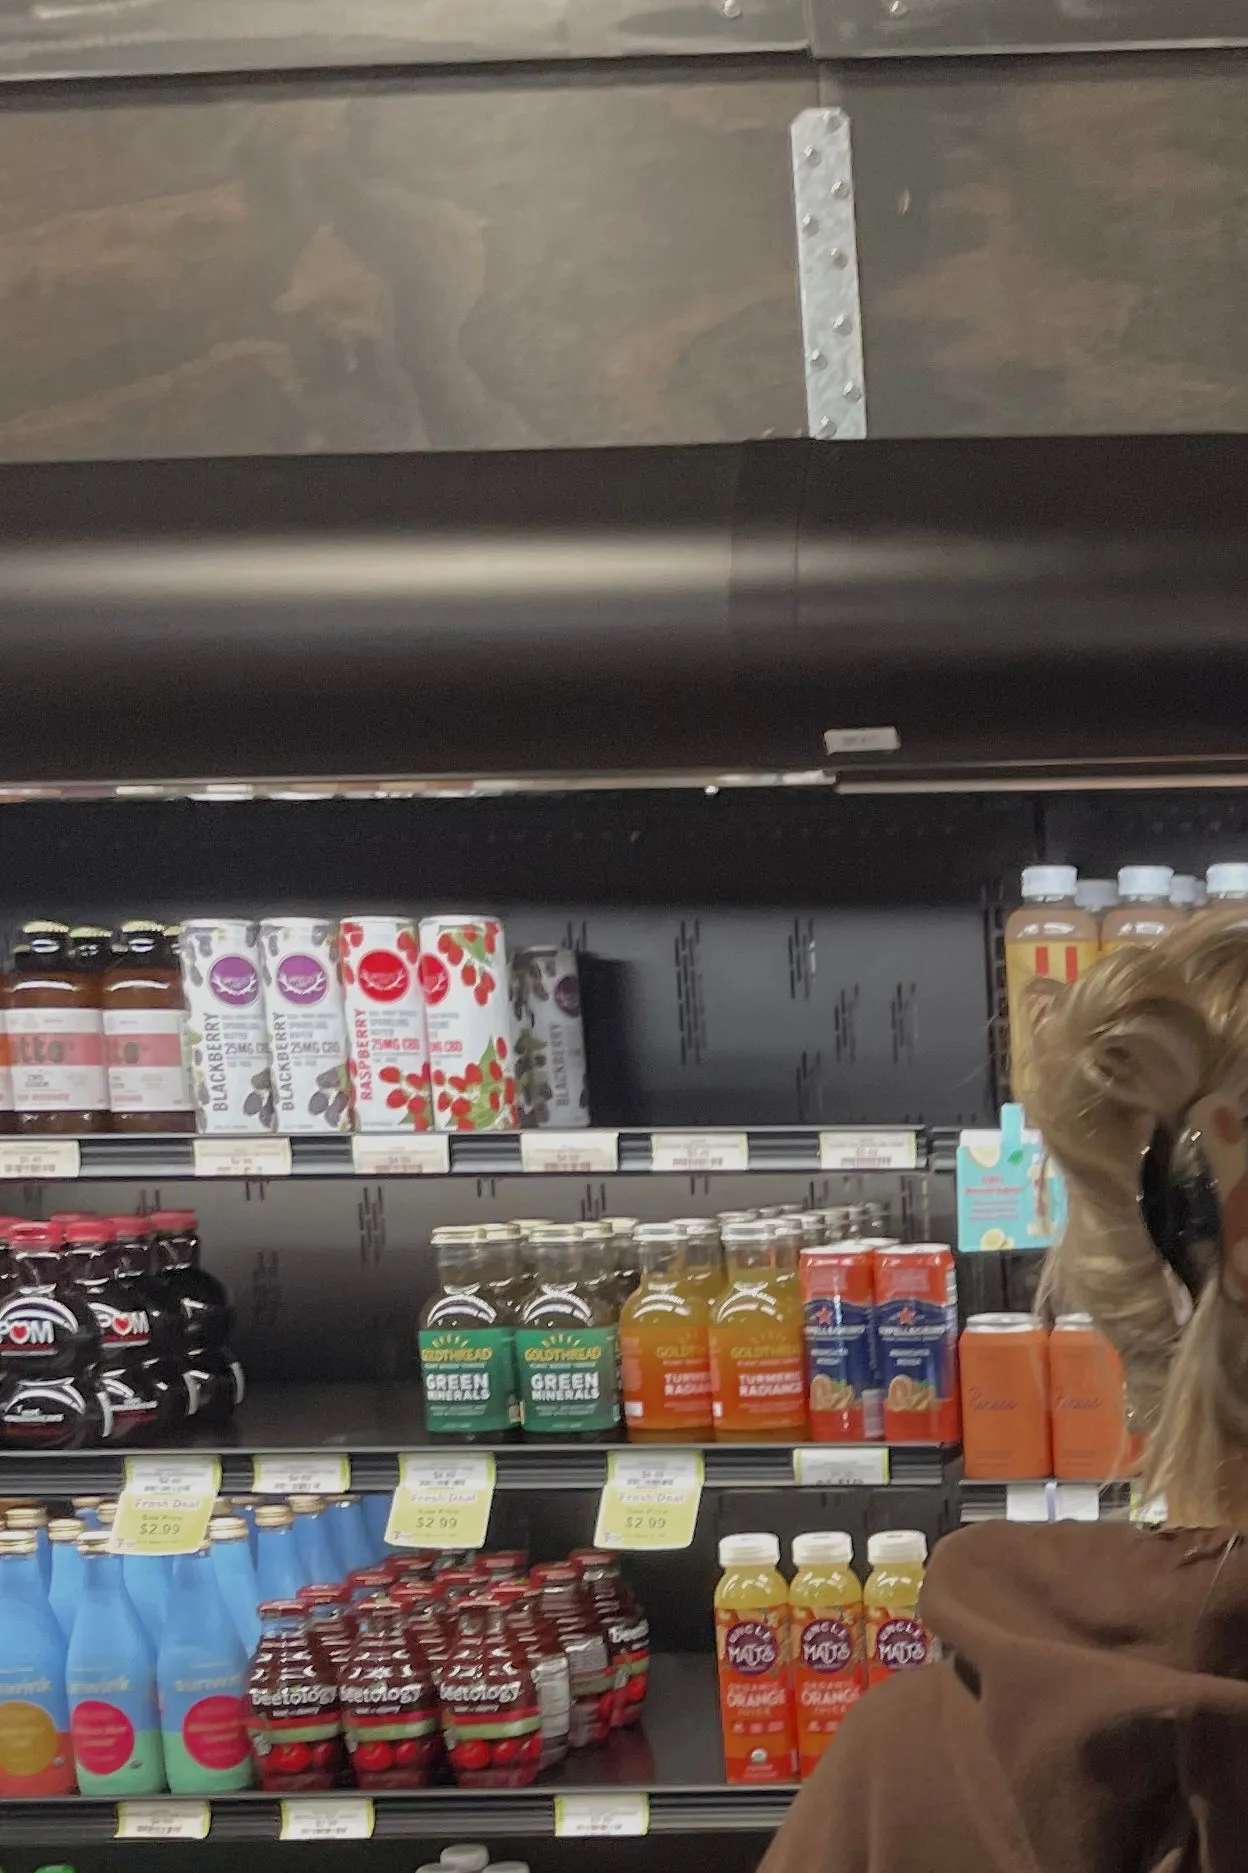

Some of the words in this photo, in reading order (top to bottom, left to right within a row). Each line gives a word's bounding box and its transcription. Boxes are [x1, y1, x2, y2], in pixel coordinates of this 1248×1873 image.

[203, 1012, 229, 1111] BLACKBERRY
[272, 1011, 294, 1110] BLACKBERRY
[353, 1009, 373, 1100] RASPBERRY
[426, 1373, 490, 1390] GREEN
[530, 1372, 600, 1390] GREEN
[427, 1389, 491, 1401] MINERALS
[531, 1389, 601, 1401] MINERALS
[172, 1499, 200, 1509] Deal
[448, 1493, 476, 1503] Deal
[657, 1492, 684, 1503] Deal
[140, 1523, 181, 1536] $2.99
[416, 1517, 458, 1529] $2.99
[624, 1516, 666, 1529] $2.99
[339, 1682, 423, 1703] beetology
[439, 1681, 521, 1703] beetology
[726, 1689, 787, 1708] ORANGE
